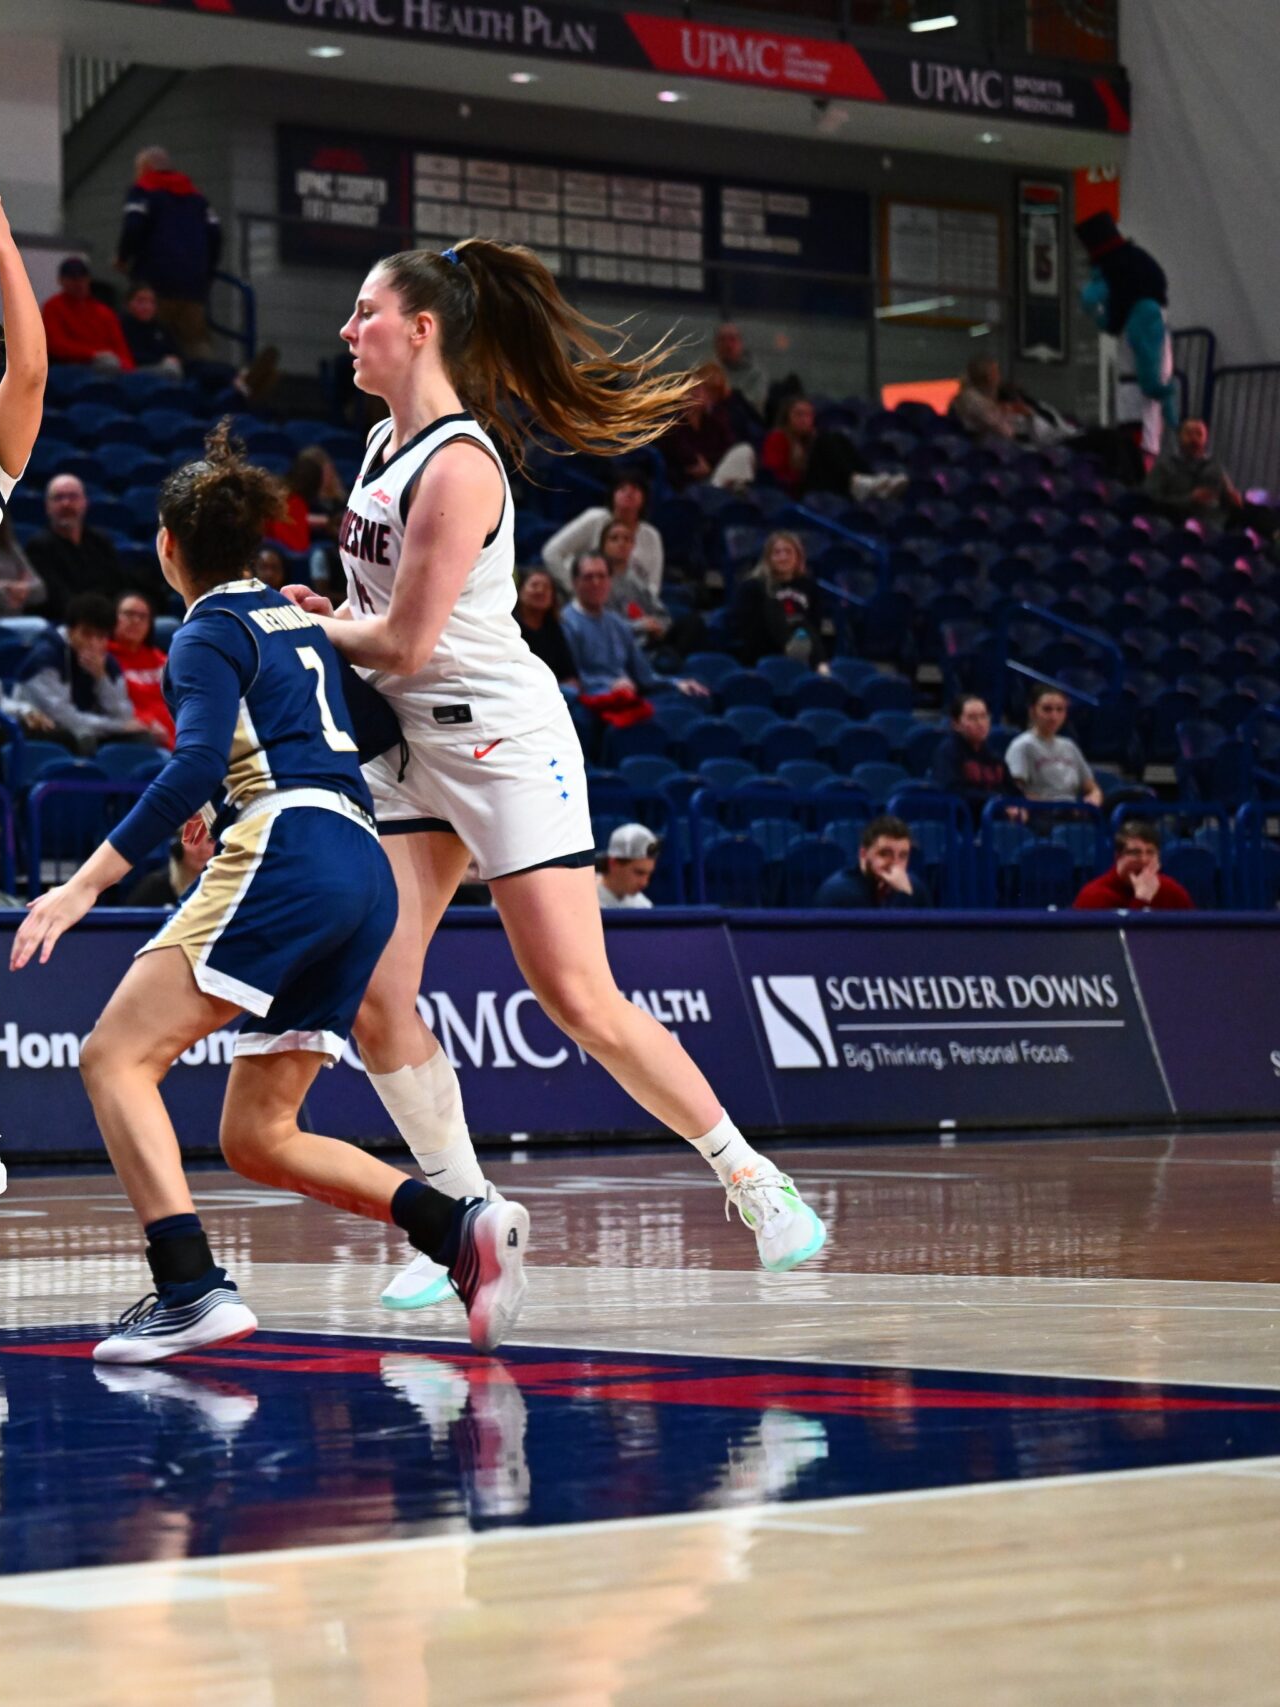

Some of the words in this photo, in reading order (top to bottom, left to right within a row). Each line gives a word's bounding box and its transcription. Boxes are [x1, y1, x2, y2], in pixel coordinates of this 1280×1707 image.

[403, 0, 515, 42] HEALTH
[523, 5, 597, 53] PLAN
[681, 28, 779, 79] UPMC
[911, 60, 1004, 109] UPMC
[295, 646, 360, 752] 1
[621, 988, 711, 1022] ALTH
[825, 975, 1007, 1011] SCHNEIDER
[1005, 974, 1119, 1009] DOWNS
[340, 988, 570, 1072] MC
[842, 1042, 874, 1072] Big
[871, 1041, 948, 1070] Thinking.
[948, 1040, 1018, 1066] Personal
